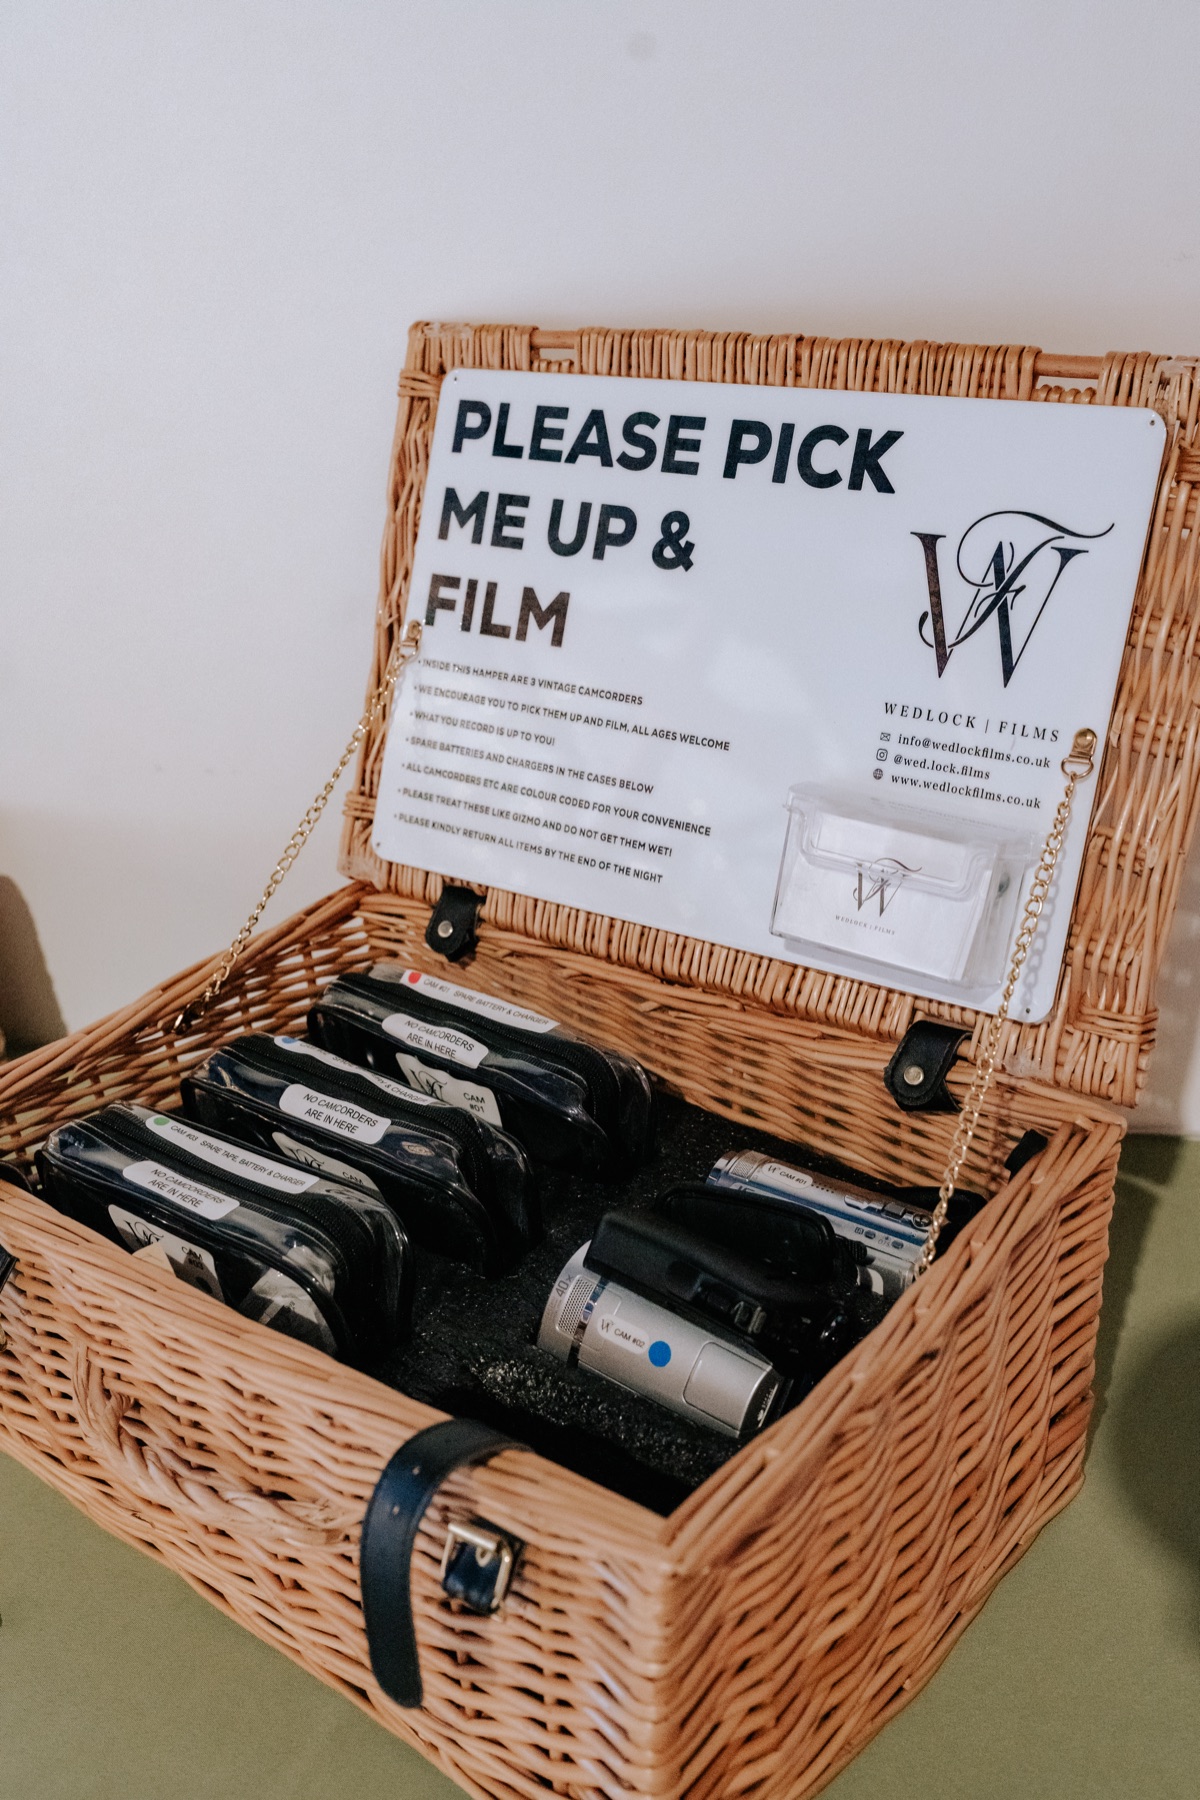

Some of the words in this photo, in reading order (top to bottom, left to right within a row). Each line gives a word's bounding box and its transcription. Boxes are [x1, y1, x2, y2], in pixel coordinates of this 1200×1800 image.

[451, 400, 707, 475] PLEASE
[723, 419, 905, 494] PICK
[438, 487, 530, 550] ME
[547, 498, 638, 560] UP
[651, 510, 696, 571] &
[424, 573, 570, 647] FILM
[422, 659, 450, 672] INSIDE
[452, 664, 471, 676] THIS
[472, 667, 508, 682] HAMPER
[510, 674, 529, 686] ARE
[530, 678, 536, 687] 3
[538, 679, 576, 694] VINTAGE
[578, 686, 643, 705] CAMCORDERS
[414, 710, 439, 722] WHAT
[441, 714, 458, 727] YOU
[459, 718, 495, 734] RECORD
[496, 727, 504, 736] IS
[506, 729, 518, 739] UP
[520, 731, 532, 742] TO
[533, 734, 556, 746] YOU!
[419, 684, 432, 695] WE
[434, 687, 486, 706] ENCOURAGE
[487, 697, 505, 709] YOU
[507, 701, 519, 712] TO
[521, 704, 540, 716] PICK
[543, 708, 567, 720] THEM
[570, 712, 582, 722] UP
[584, 716, 604, 728] AND
[632, 725, 649, 736] ALL
[651, 728, 677, 741] AGES
[680, 733, 730, 751] WELCOME
[884, 702, 977, 729] WEDLOCK
[999, 721, 1060, 743] FILMS
[410, 737, 437, 750] SPARE
[439, 742, 484, 760] BATTERIES
[486, 752, 505, 764] AND
[506, 756, 554, 774] CHARGERS
[556, 766, 566, 776] IN
[568, 768, 585, 780] THE
[586, 772, 617, 787] CASES
[619, 779, 654, 794] BELOW
[893, 754, 991, 780] @wed.lock.films
[898, 734, 1051, 769] info@wedlockfilms.co.uk
[406, 762, 422, 774] ALL
[423, 766, 482, 786] CAMCORDERS
[483, 778, 500, 790] ETC
[501, 782, 518, 794] ARE
[520, 786, 557, 803] COLOUR
[558, 795, 591, 810] CODED
[592, 802, 612, 815] FOR
[613, 807, 640, 820] YOUR
[641, 813, 712, 837] CONVENIENCE
[891, 774, 1042, 809] www.wedlockfilms.co.uk
[402, 788, 434, 802] PLEASE
[436, 794, 462, 808] TREAT
[464, 801, 490, 816] THESE
[492, 808, 510, 820] LIKE
[512, 812, 542, 827] GIZMO
[542, 820, 562, 832] AND
[564, 825, 578, 835] DO
[579, 828, 600, 840] NOT
[600, 832, 618, 845] GET
[620, 837, 646, 850] THEM
[648, 843, 673, 858] WET!
[398, 813, 430, 828] PLEASE
[431, 821, 461, 836] KINDLY
[462, 828, 497, 844] RETURN
[498, 837, 514, 848] ALL
[516, 840, 543, 855] ITEMS
[544, 848, 556, 858] BY
[558, 852, 576, 863] THE
[577, 856, 596, 868] END
[598, 860, 612, 871] OF
[613, 864, 632, 876] THE
[632, 868, 664, 884] NIGHT
[835, 914, 868, 928] WEDLOCK
[423, 978, 440, 990] CAM
[438, 984, 450, 994] #01
[453, 990, 476, 1004] SPARE
[476, 996, 506, 1012] BATTERY
[506, 1008, 513, 1016] &
[513, 1010, 550, 1026] CHARGER
[404, 1020, 418, 1029] NO
[418, 1026, 475, 1052] CAMCORDERS
[406, 1032, 423, 1046] ARE
[424, 1040, 433, 1050] IN
[434, 1042, 457, 1058] HERE
[303, 1092, 319, 1104] NO
[318, 1098, 379, 1128] CAMCORDERS
[463, 1092, 486, 1104] CAM
[469, 1103, 485, 1113] #01
[304, 1108, 323, 1122] ARE
[324, 1114, 334, 1126] IN
[334, 1118, 360, 1134] HERE
[170, 1124, 187, 1138] CAM
[186, 1132, 199, 1142] #03
[200, 1140, 222, 1156] SPARE
[239, 1158, 267, 1176] BATTERY
[266, 1169, 273, 1177] &
[273, 1172, 306, 1188] CHARGER
[148, 1178, 166, 1192] ARE
[166, 1186, 176, 1197] IN
[176, 1190, 204, 1209] HERE
[151, 1168, 167, 1181] NO
[164, 1174, 226, 1204] CAMCORDERS
[779, 1171, 796, 1181] CAM
[614, 1328, 632, 1341] CAM
[632, 1338, 646, 1348] #02
